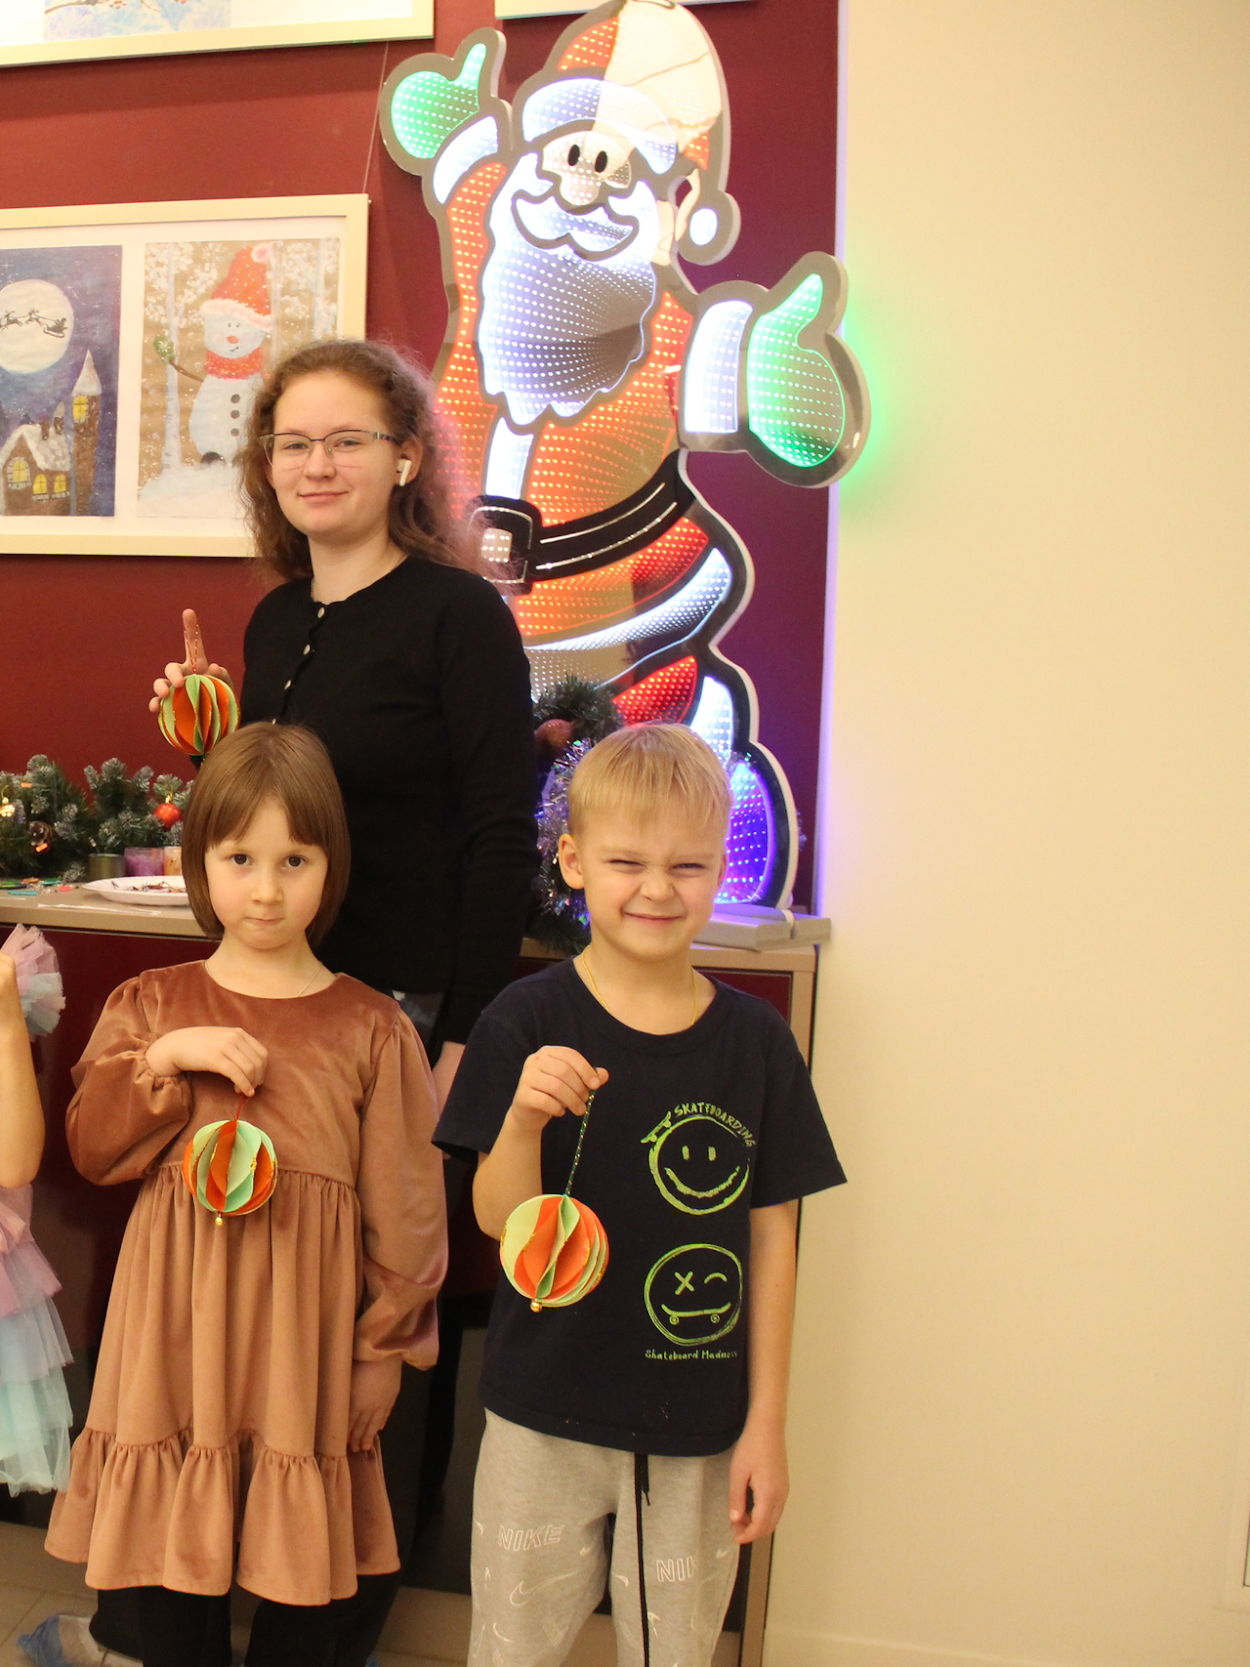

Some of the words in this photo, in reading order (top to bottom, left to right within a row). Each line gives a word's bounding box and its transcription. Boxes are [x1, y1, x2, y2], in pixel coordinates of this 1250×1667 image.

[674, 1102, 756, 1147] SKATEBOARDING
[645, 1349, 699, 1361] Skateboard
[498, 1523, 565, 1551] NIKE
